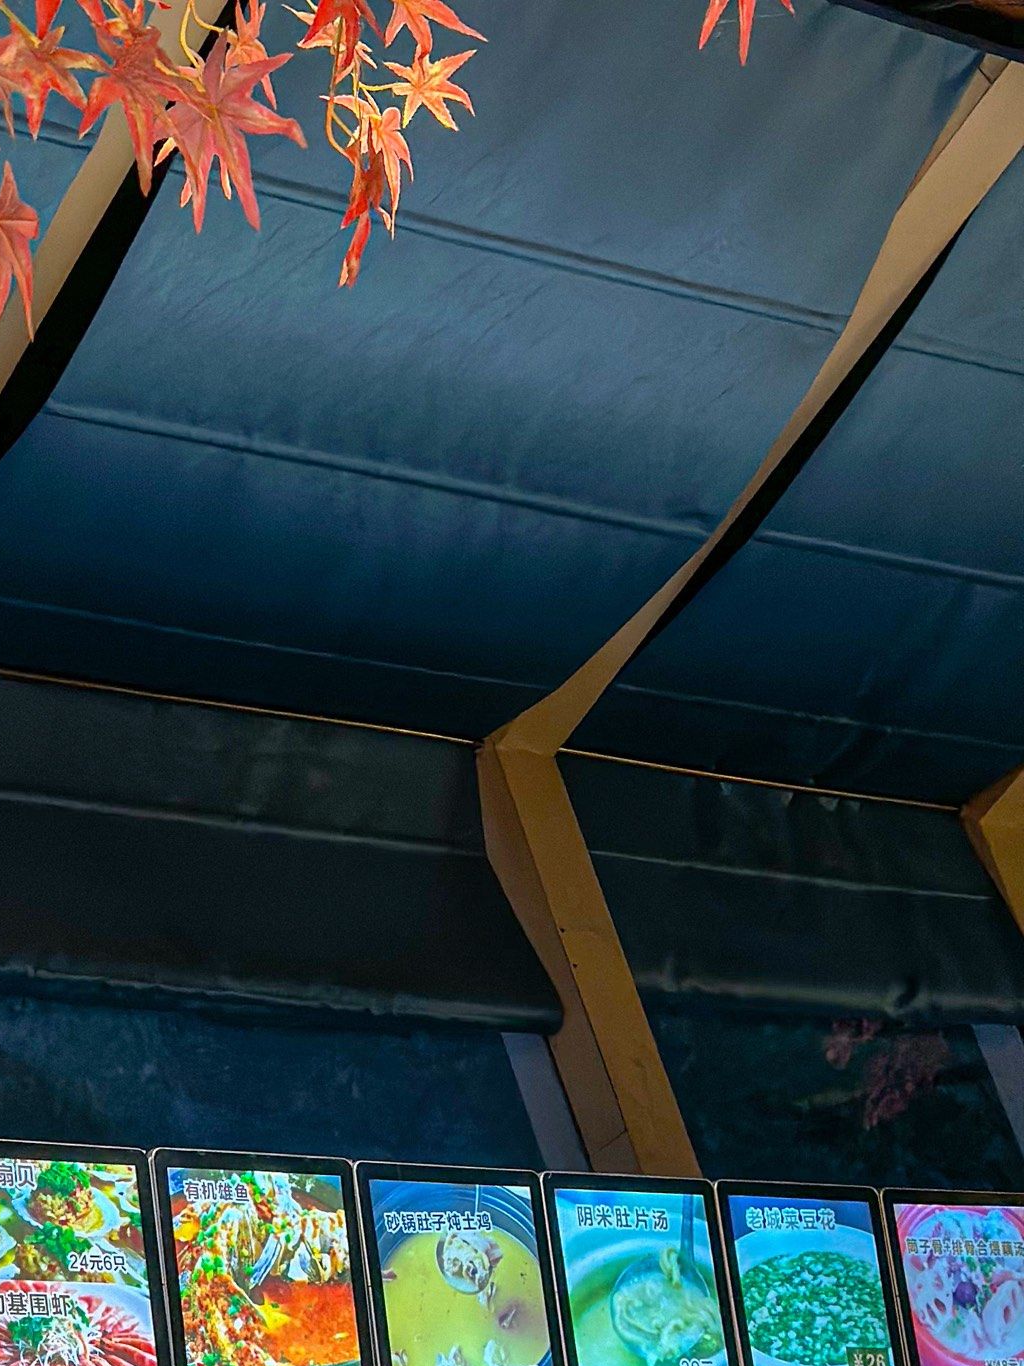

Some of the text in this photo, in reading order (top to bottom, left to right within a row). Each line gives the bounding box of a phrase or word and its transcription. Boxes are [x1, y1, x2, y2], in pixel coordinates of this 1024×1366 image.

[184, 1180, 250, 1202] 有机雄鱼
[385, 1212, 492, 1233] 砂锅肚子炖土鸡
[577, 1206, 668, 1230] 阴米肚片汤
[746, 1207, 835, 1230] 老城菜豆花
[69, 1253, 127, 1272] 24元6只
